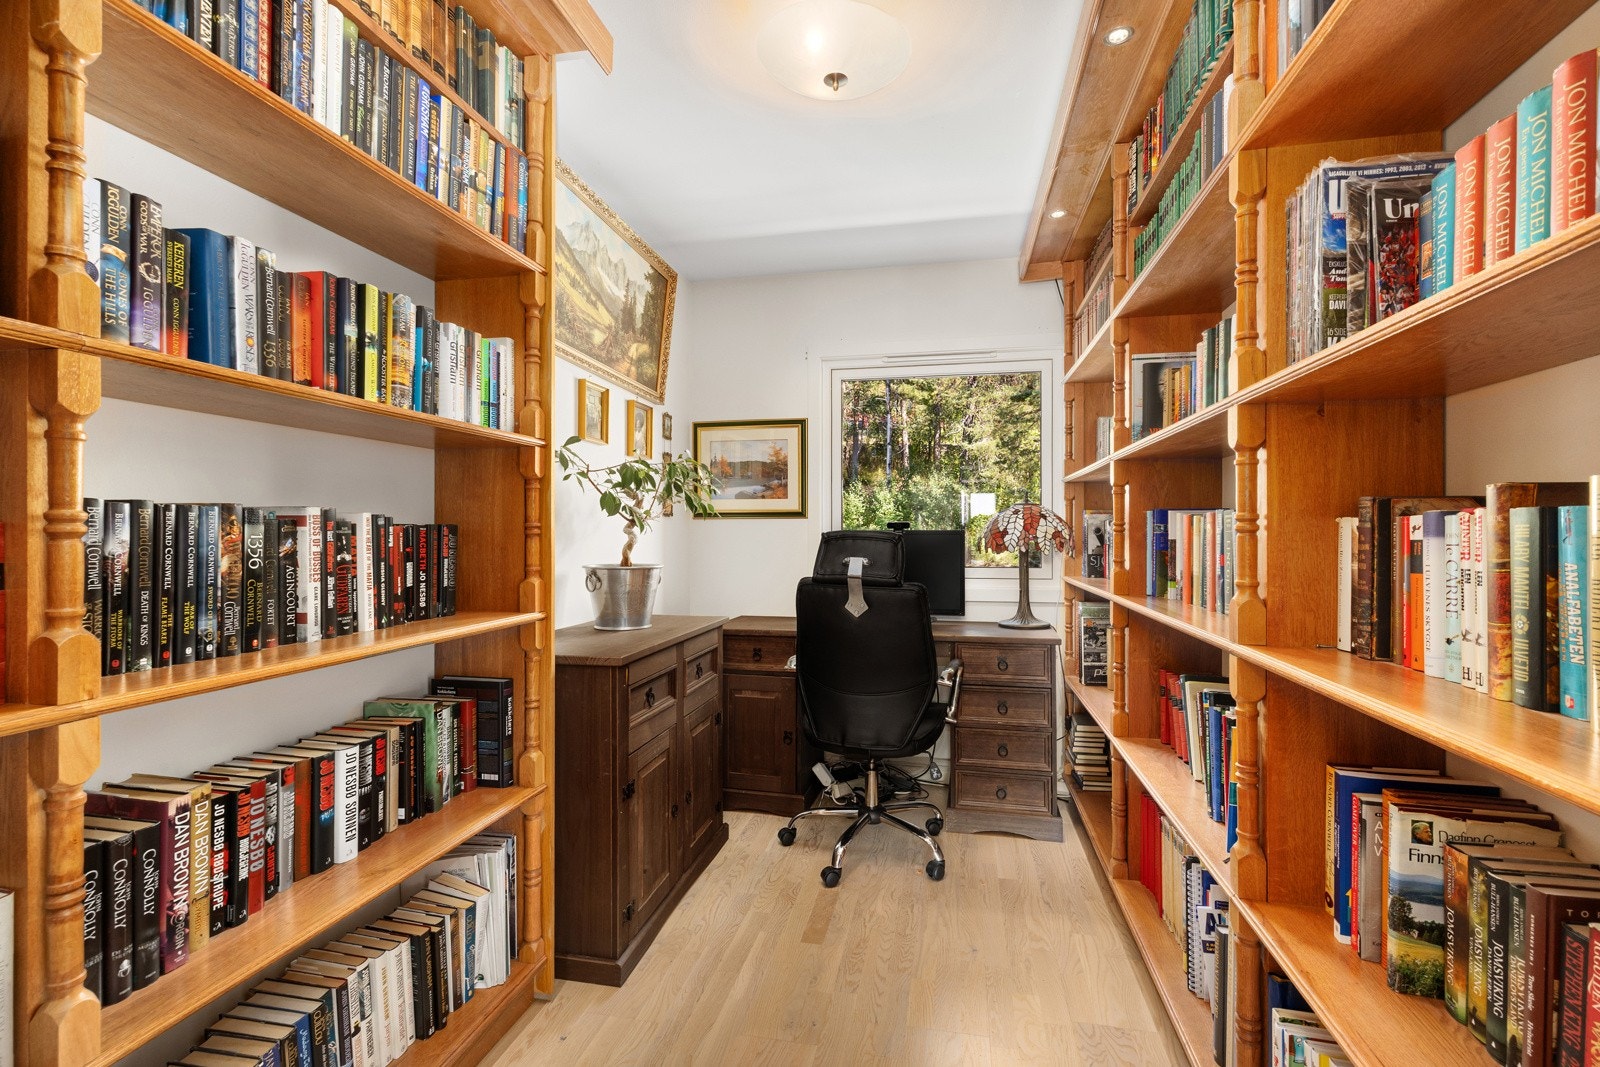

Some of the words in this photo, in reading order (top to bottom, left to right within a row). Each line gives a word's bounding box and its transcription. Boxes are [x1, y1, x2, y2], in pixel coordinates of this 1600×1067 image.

[1562, 78, 1588, 127] JON
[1527, 110, 1548, 156] JON
[1494, 136, 1511, 180] JON
[1462, 158, 1477, 200] JON
[107, 185, 119, 244] IGGULDEN
[119, 205, 128, 231] CONN
[140, 200, 148, 226] GODS
[1434, 182, 1448, 218] JON
[140, 232, 148, 255] WAR
[105, 267, 116, 291] THE
[118, 271, 128, 309] BONES
[104, 293, 116, 325] HILLS
[165, 511, 173, 546] BERNARD
[188, 512, 196, 547] BERNARD
[312, 514, 321, 536] BOSS
[312, 537, 321, 549] OF
[1513, 523, 1531, 563] HILARY
[164, 547, 174, 590] CORNWELL
[187, 547, 196, 589] CORNWELL
[207, 544, 216, 585] CORNWELL
[247, 533, 264, 569] 1356
[312, 551, 321, 583] BOSSES
[419, 530, 427, 570] MACBETH
[419, 571, 426, 581] JO
[1464, 568, 1472, 584] LEN
[1513, 566, 1531, 611] MANTEL
[140, 590, 149, 614] DEATH
[246, 579, 256, 627] CORNWELL
[286, 565, 296, 627] AGINCOURT
[1563, 562, 1586, 665] ANALFABETEN
[140, 624, 149, 646] KINGS
[160, 620, 168, 645] BEARER
[345, 752, 357, 765] JO
[194, 801, 209, 834] DAN
[214, 803, 225, 816] JO
[250, 796, 265, 816] JO
[174, 811, 190, 850] DAN
[142, 848, 157, 918] CONNOLLY
[173, 850, 190, 910] BROWN
[194, 836, 209, 895] BROWN
[112, 858, 128, 929] CONNOLLY
[1445, 905, 1456, 986] JOMSVIKING
[1473, 921, 1484, 997] JOMSVIKING
[1493, 939, 1505, 1019] JOMSVIKING
[1563, 935, 1585, 1004] STEPHEN
[1562, 1005, 1584, 1050] KING
